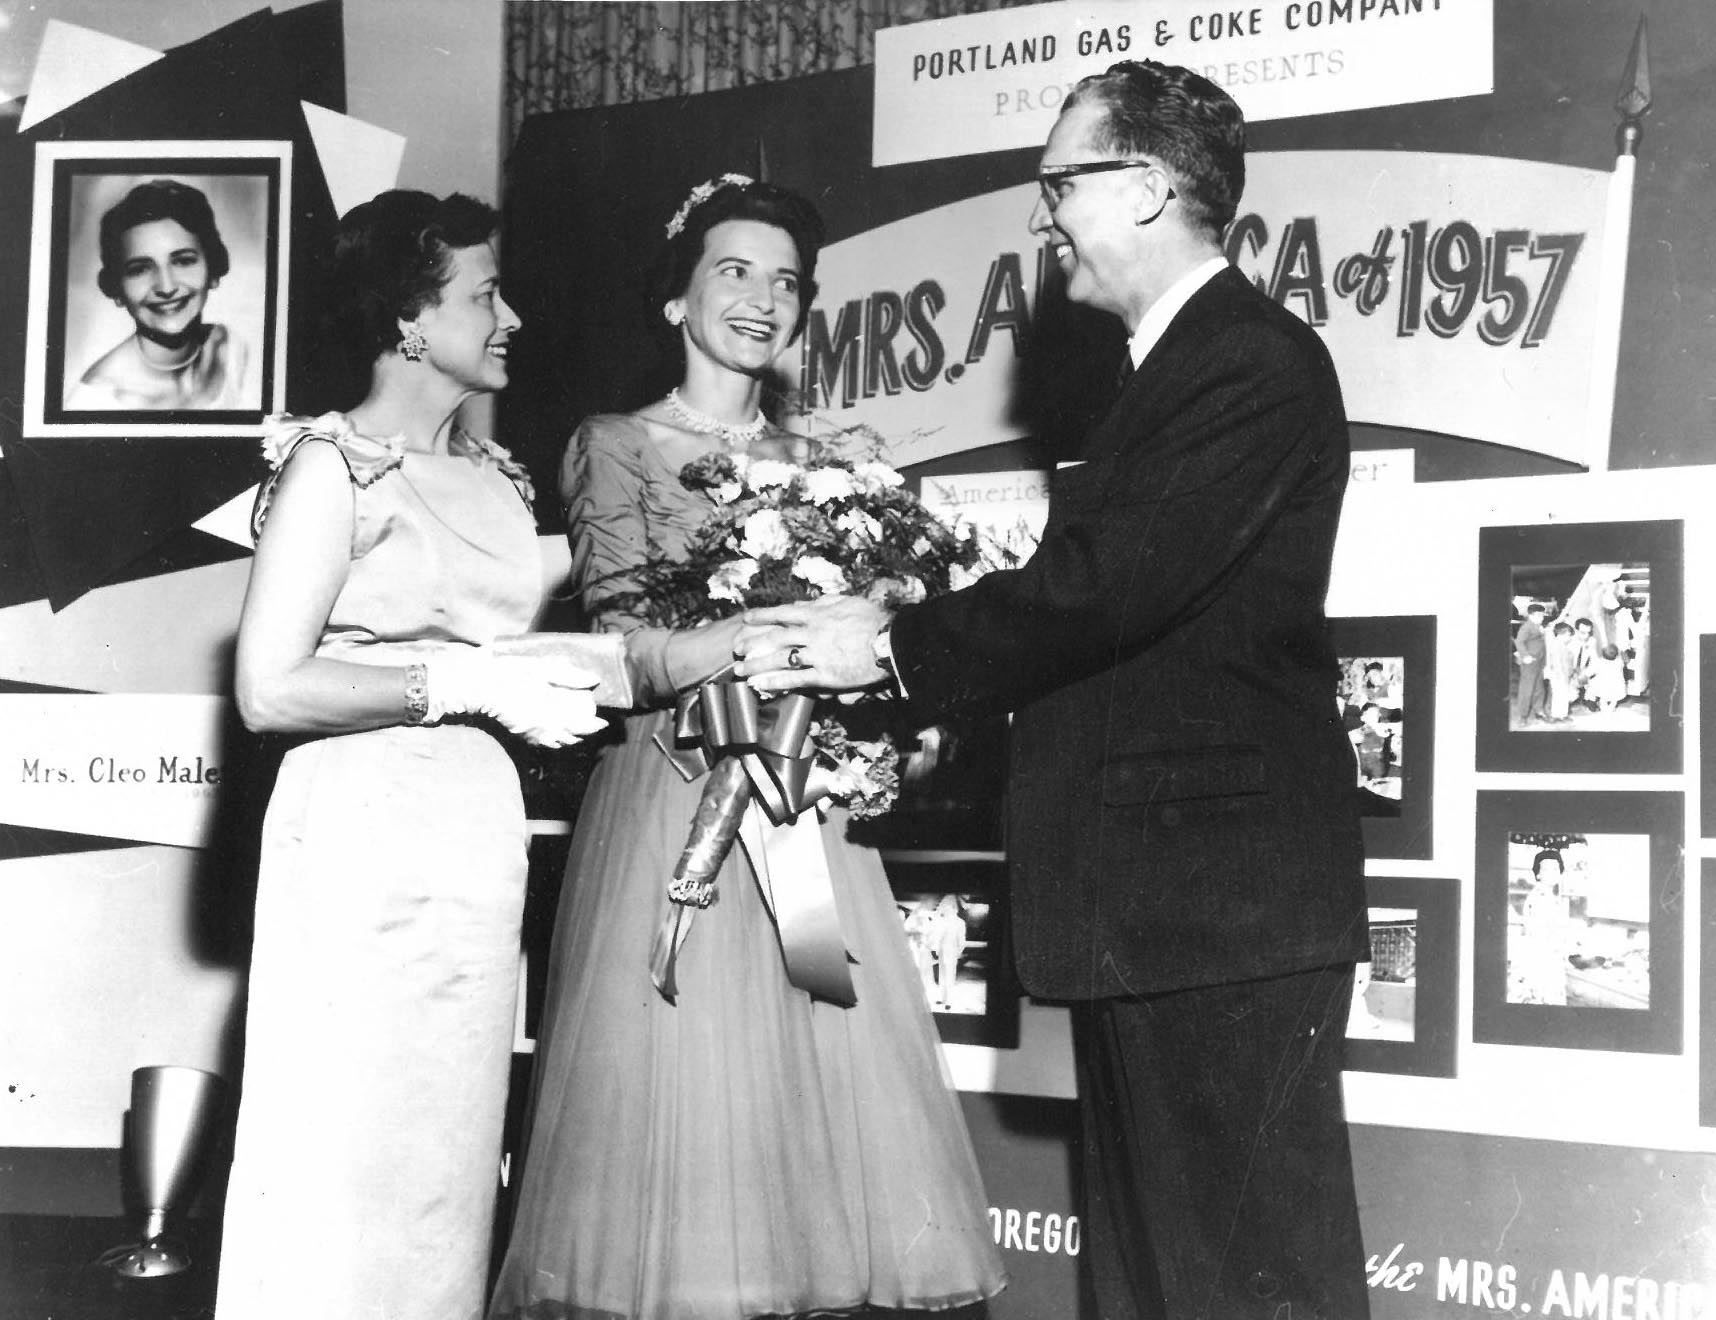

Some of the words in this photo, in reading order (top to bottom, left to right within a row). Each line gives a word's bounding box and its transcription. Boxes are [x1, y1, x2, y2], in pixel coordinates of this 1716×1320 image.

[913, 34, 1057, 82] PORTLAND
[1078, 24, 1132, 57] GAS
[1155, 19, 1175, 47] &
[1189, 8, 1262, 42] COKE
[994, 83, 1075, 116] PRO
[1189, 49, 1345, 87] RESENTS
[800, 279, 965, 417] MRS.
[1333, 226, 1395, 316] of
[1396, 219, 1588, 349] 1957
[21, 758, 75, 783] Mrs.
[88, 757, 146, 783] Cleo
[157, 757, 222, 784] Male
[1437, 1256, 1532, 1313] MRS.
